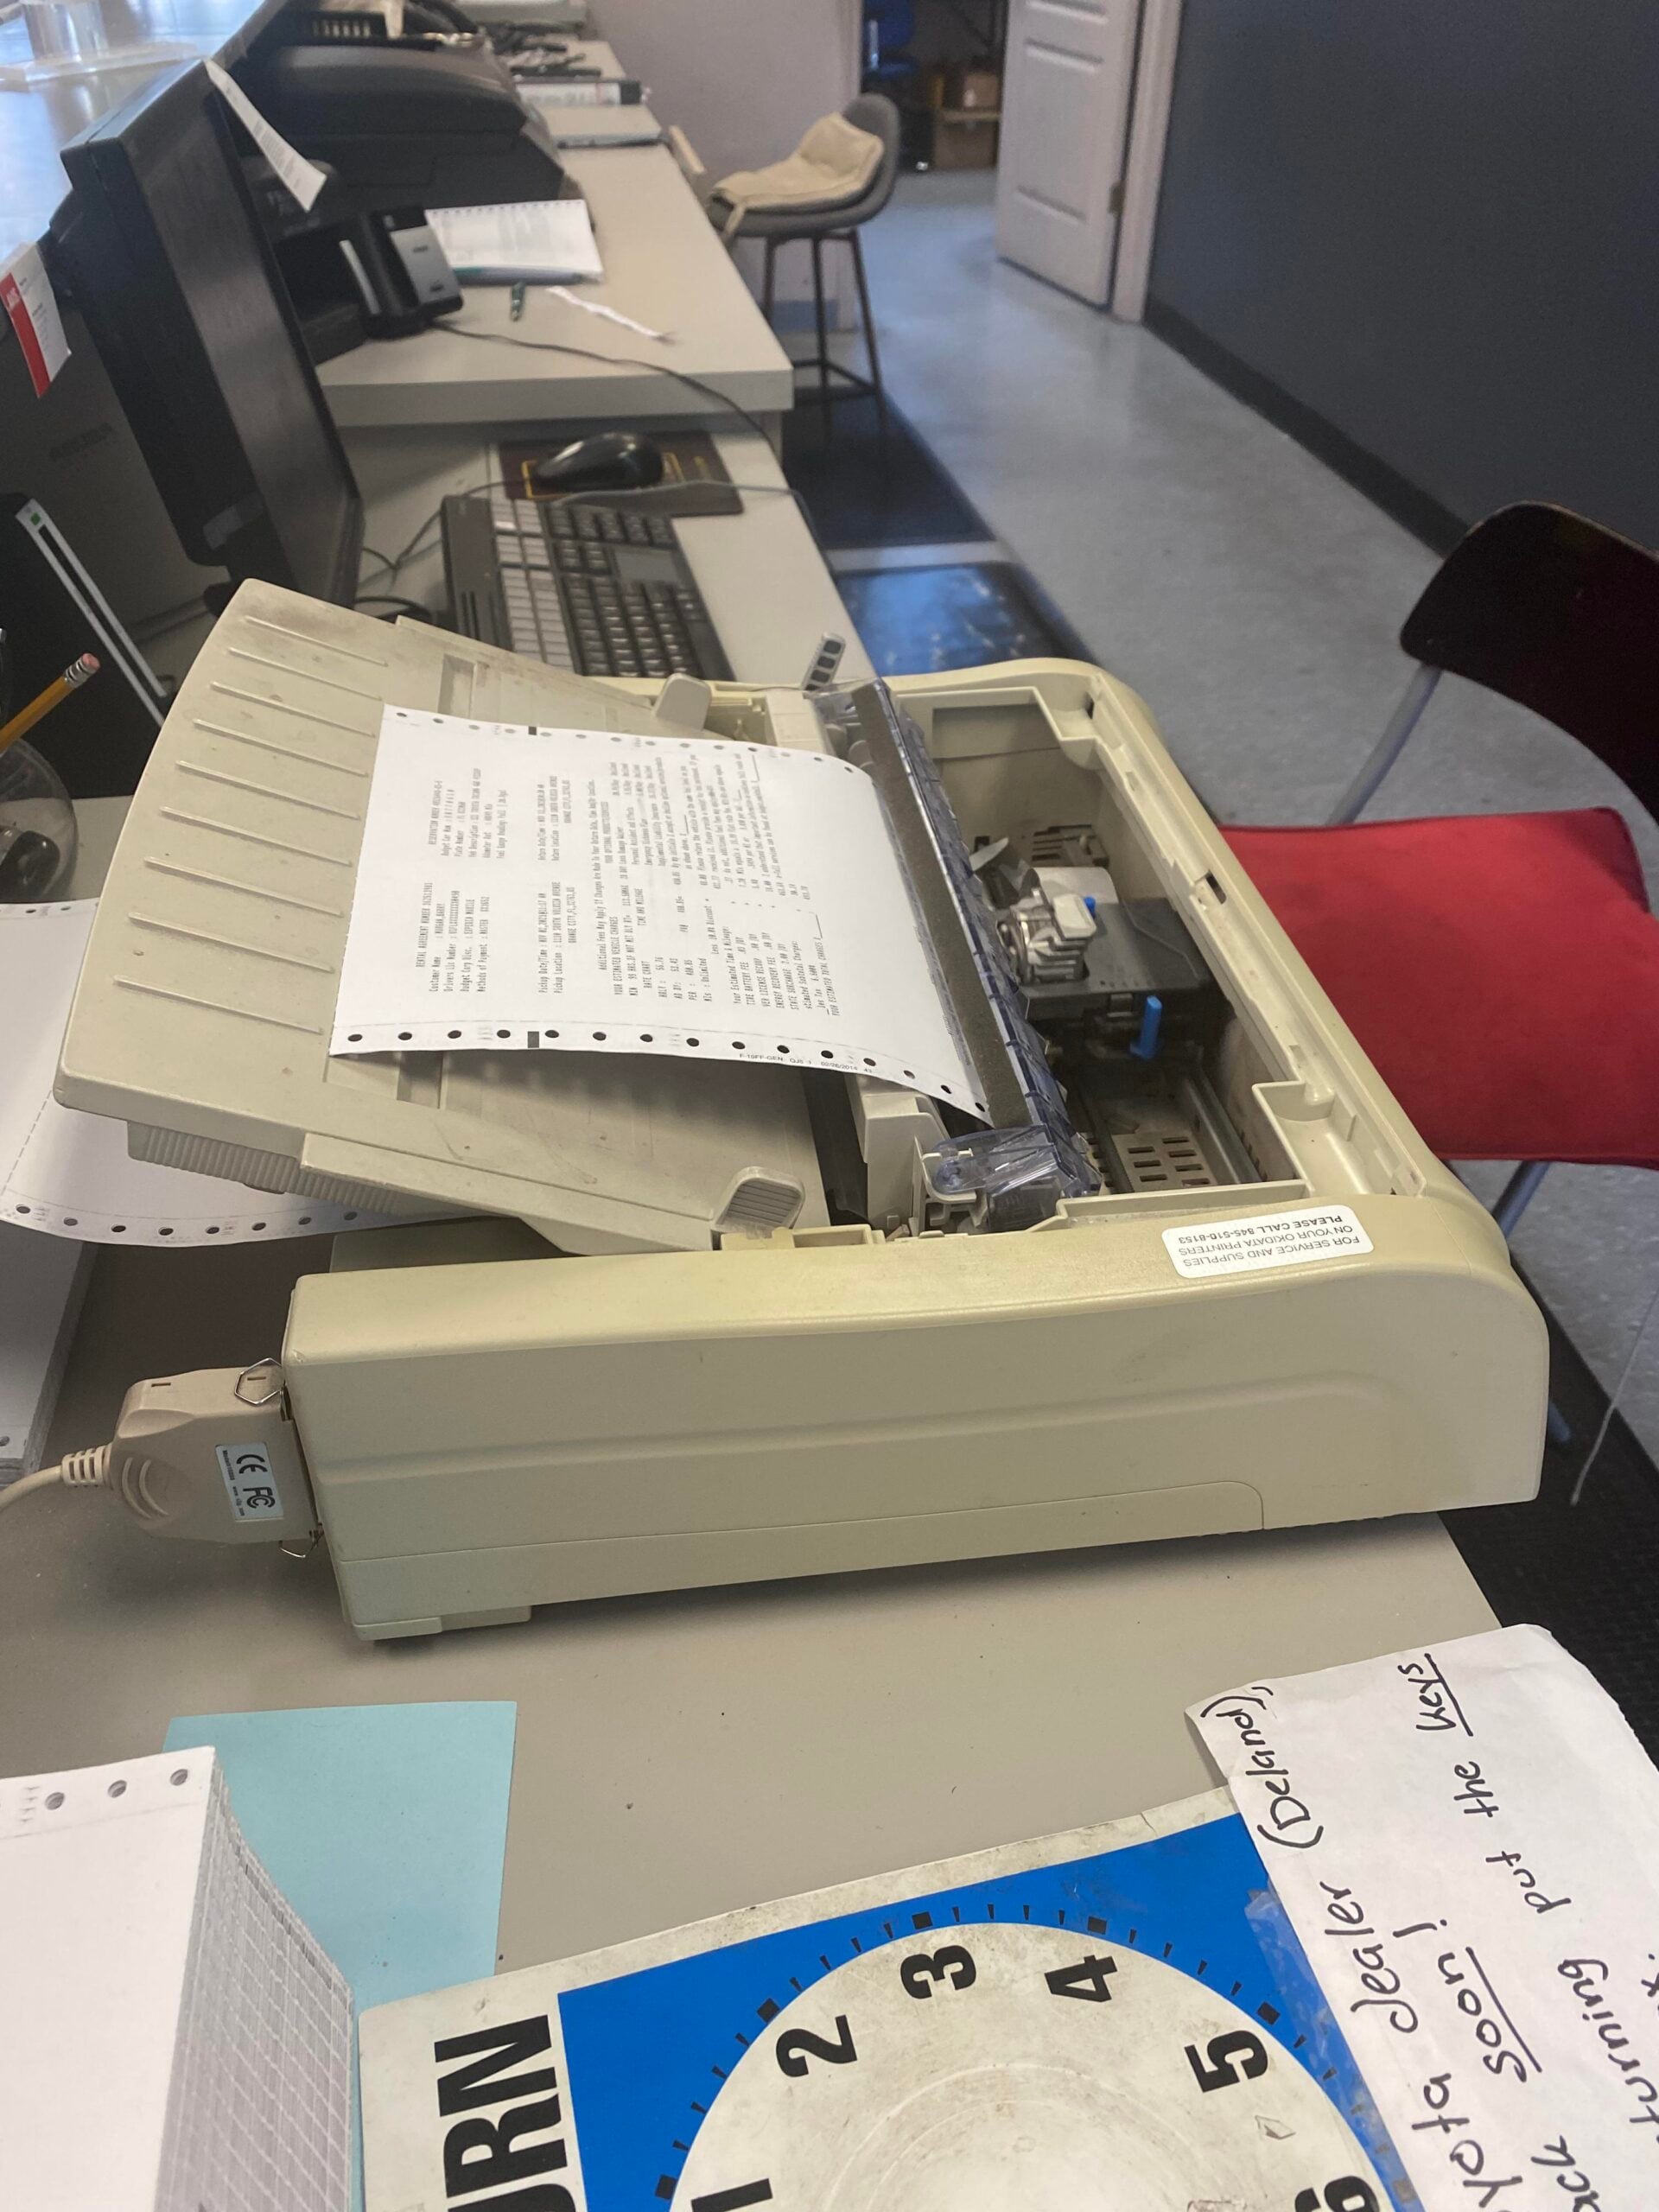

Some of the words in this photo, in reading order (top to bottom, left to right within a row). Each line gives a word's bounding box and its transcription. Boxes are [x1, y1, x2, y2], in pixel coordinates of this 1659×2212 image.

[594, 881, 604, 898] Changes
[594, 906, 607, 918] Apply
[704, 906, 715, 925] Discount
[595, 921, 607, 930] May
[609, 917, 619, 935] CHARGES
[596, 931, 606, 942] Fees
[446, 944, 456, 960] Number
[478, 944, 490, 963] Payment
[610, 937, 620, 955] VEHICLE
[815, 942, 826, 960] CHARGES
[431, 957, 441, 967] Name
[553, 952, 563, 975] Location
[597, 944, 607, 970] Additional
[726, 953, 734, 963] Time
[766, 957, 777, 965] FEE
[461, 963, 474, 973] Corp
[612, 957, 622, 982] ESTIMATED
[641, 961, 652, 975] CHART
[698, 958, 709, 982] Unlimited
[740, 962, 749, 970] FEE
[794, 963, 808, 985] Subtotal
[820, 963, 830, 975] TOTAL
[429, 969, 440, 992] Customer
[443, 972, 454, 992] Drivers
[460, 975, 473, 992] Budget
[477, 972, 486, 992] Methods
[538, 976, 550, 993] Pickup
[553, 977, 565, 994] Pickup
[643, 976, 652, 988] RATE
[728, 965, 740, 990] Estimated
[741, 972, 753, 991] BATTERY
[756, 976, 769, 995] LICENSE
[767, 967, 781, 989] RECOVERY
[781, 969, 797, 994] SURCHARGE
[613, 984, 623, 995] YOUR
[688, 992, 697, 1001] PER
[733, 993, 741, 1003] Your
[823, 977, 837, 1003] ESTIMATED
[745, 994, 755, 1005] TIRE
[773, 991, 785, 1008] ENERGY
[788, 995, 799, 1010] STATE
[1255, 1222, 1290, 1234] CALL
[1292, 1215, 1343, 1229] PLEASE
[1334, 1224, 1353, 1234] ON
[1178, 1228, 1255, 1244] 845-510-8153
[1243, 1233, 1295, 1247] OKIDATA
[1296, 1228, 1333, 1239] YOUR
[1332, 1235, 1360, 1245] FOR
[1178, 1241, 1241, 1255] PRINTERS
[1247, 1248, 1273, 1258] AND
[1275, 1239, 1331, 1254] SERVICE
[1182, 1252, 1243, 1267] SUPPLIES
[237, 1454, 268, 1474] CE
[1453, 1761, 1500, 1818] the
[1485, 1850, 1572, 1914] put
[1319, 1881, 1419, 2034] dealer
[776, 2015, 858, 2077] 2
[899, 1945, 977, 1999] 3
[1045, 1955, 1118, 2003] 4
[1185, 2030, 1269, 2093] 5
[1412, 2072, 1523, 2212] yota
